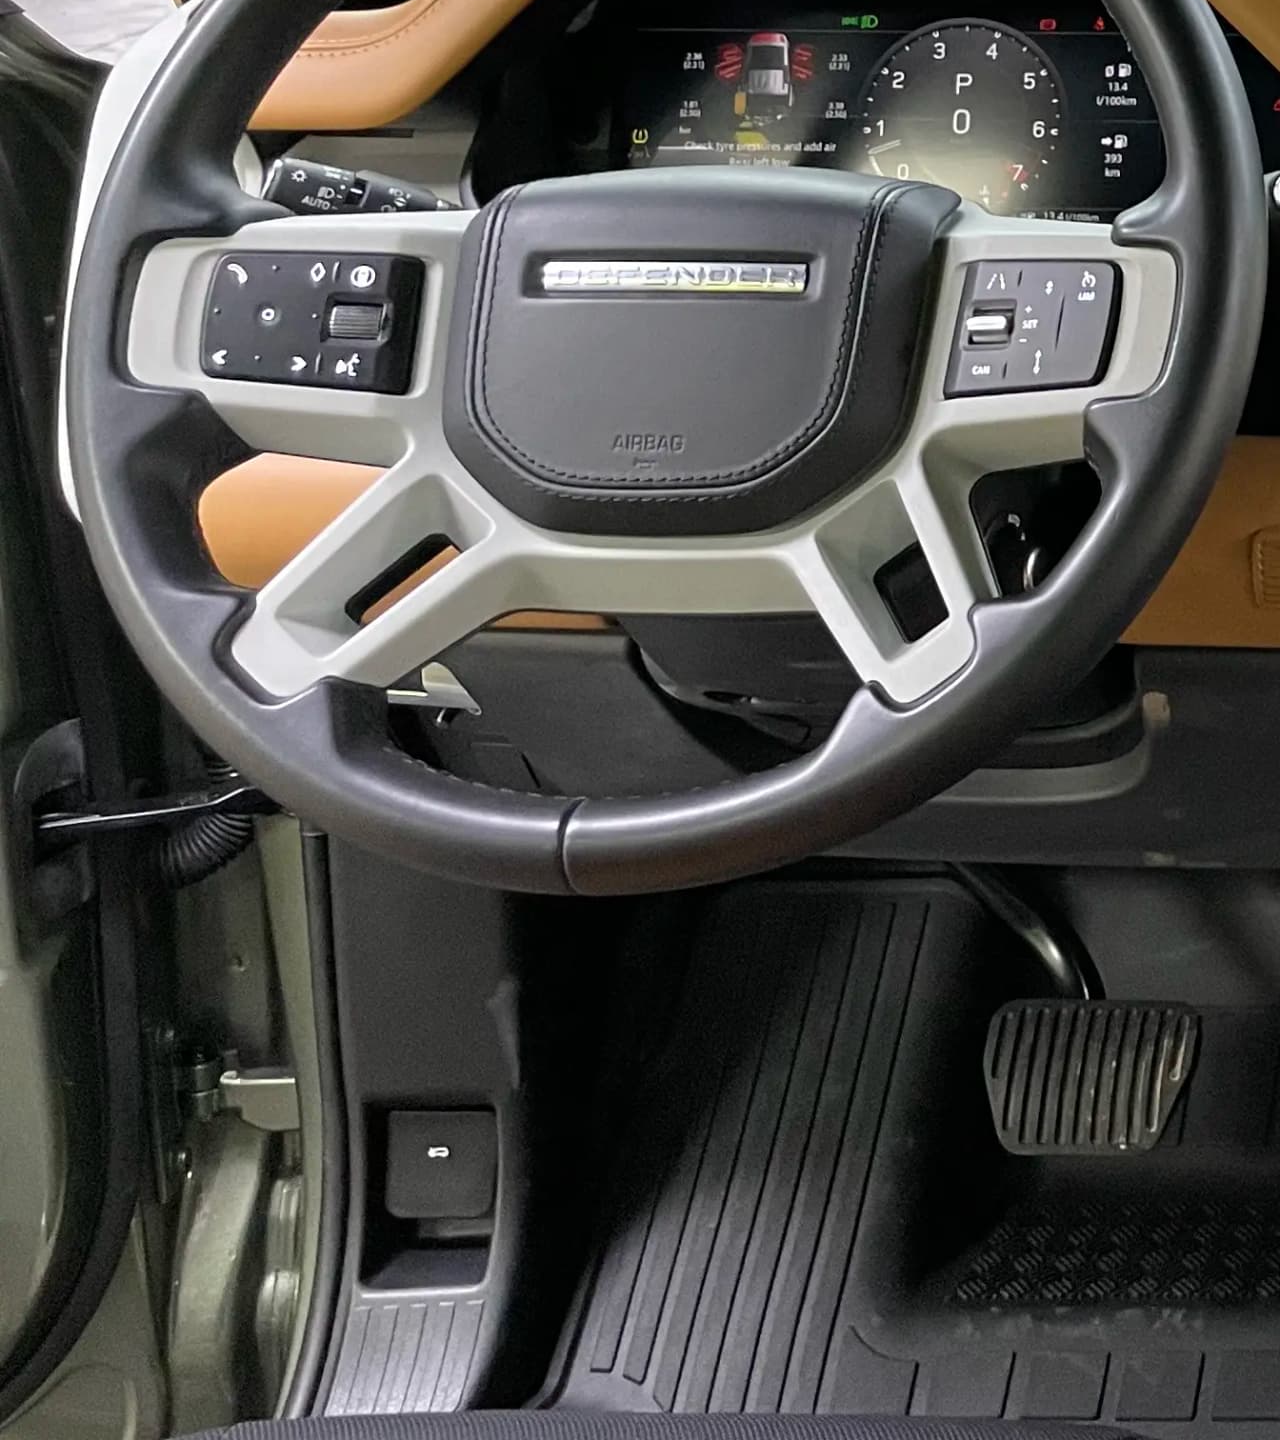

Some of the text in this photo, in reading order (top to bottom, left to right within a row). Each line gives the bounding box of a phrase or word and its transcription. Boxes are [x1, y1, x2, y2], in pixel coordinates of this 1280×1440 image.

[933, 43, 946, 60] 3
[986, 43, 998, 60] 4
[891, 71, 905, 89] 2
[956, 73, 973, 95] P
[1023, 72, 1036, 89] 5
[1108, 82, 1128, 92] 13.4
[876, 120, 885, 137] 1
[953, 109, 971, 135] 0
[1033, 121, 1046, 138] 6
[715, 143, 734, 153] tyre
[784, 141, 802, 151] and
[804, 141, 822, 151] add
[824, 142, 837, 152] air
[1104, 154, 1122, 164] 393
[1012, 165, 1023, 180] 7
[1105, 167, 1121, 178] km
[301, 195, 331, 211] AUTO
[553, 265, 798, 288] DEFENDER
[1022, 319, 1039, 329] SET
[612, 432, 686, 453] AIRBAG
